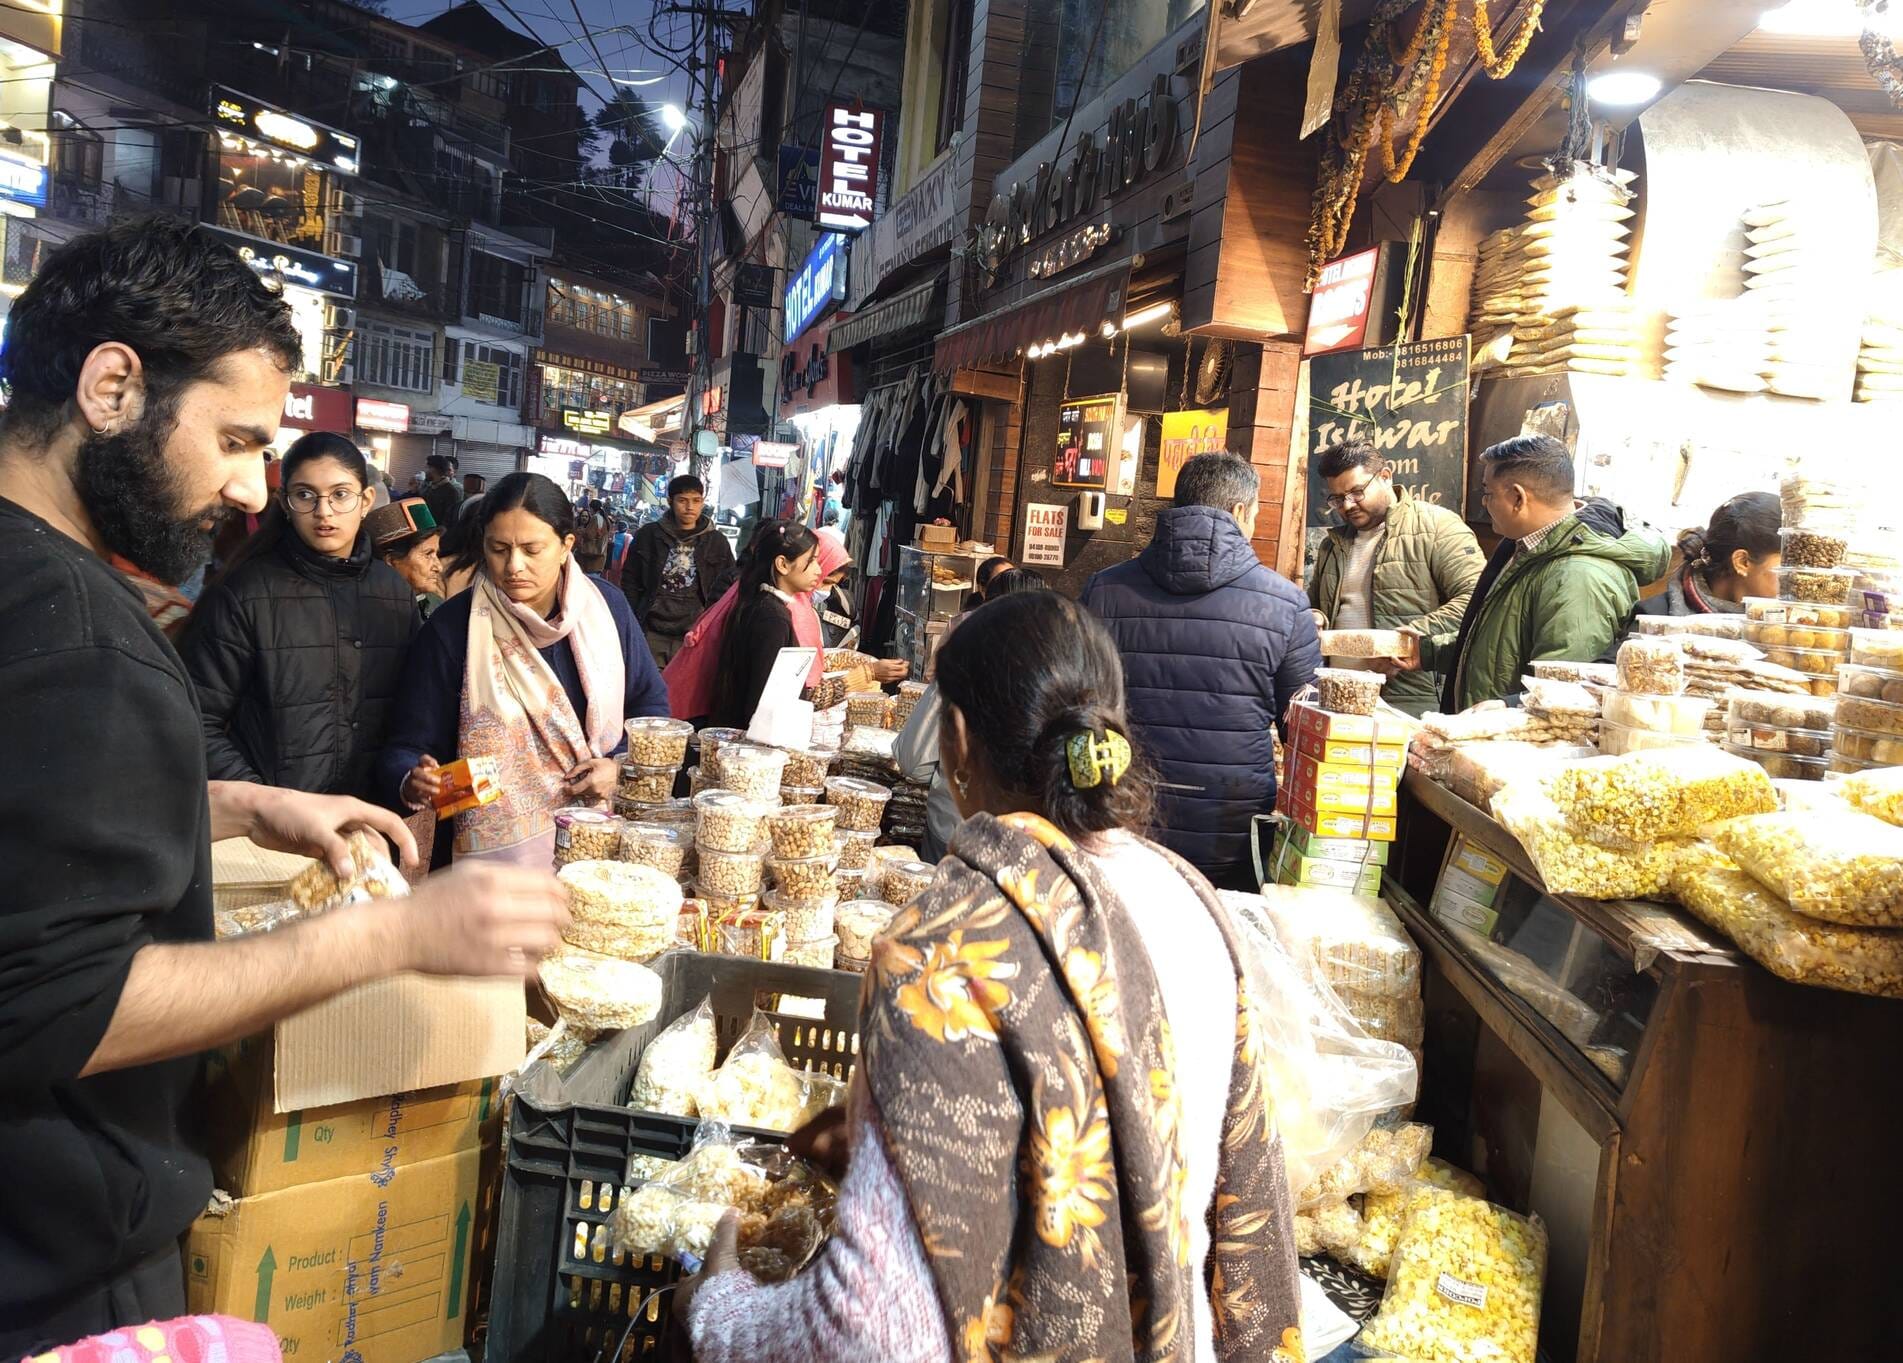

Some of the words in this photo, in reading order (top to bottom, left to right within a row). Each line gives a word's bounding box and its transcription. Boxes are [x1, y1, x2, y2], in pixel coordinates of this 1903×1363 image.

[831, 108, 874, 197] HOTEL
[822, 192, 872, 211] KUMAR
[785, 264, 813, 341] HOTEL
[1331, 367, 1442, 413] Hotel
[1314, 420, 1459, 454] Ishwar
[1030, 509, 1064, 525] FLATS
[1027, 526, 1042, 536] FOR
[1044, 527, 1064, 538] SALE
[314, 1126, 334, 1144] Qty
[369, 1200, 388, 1263] Namkeen
[280, 1336, 300, 1354] Qty
